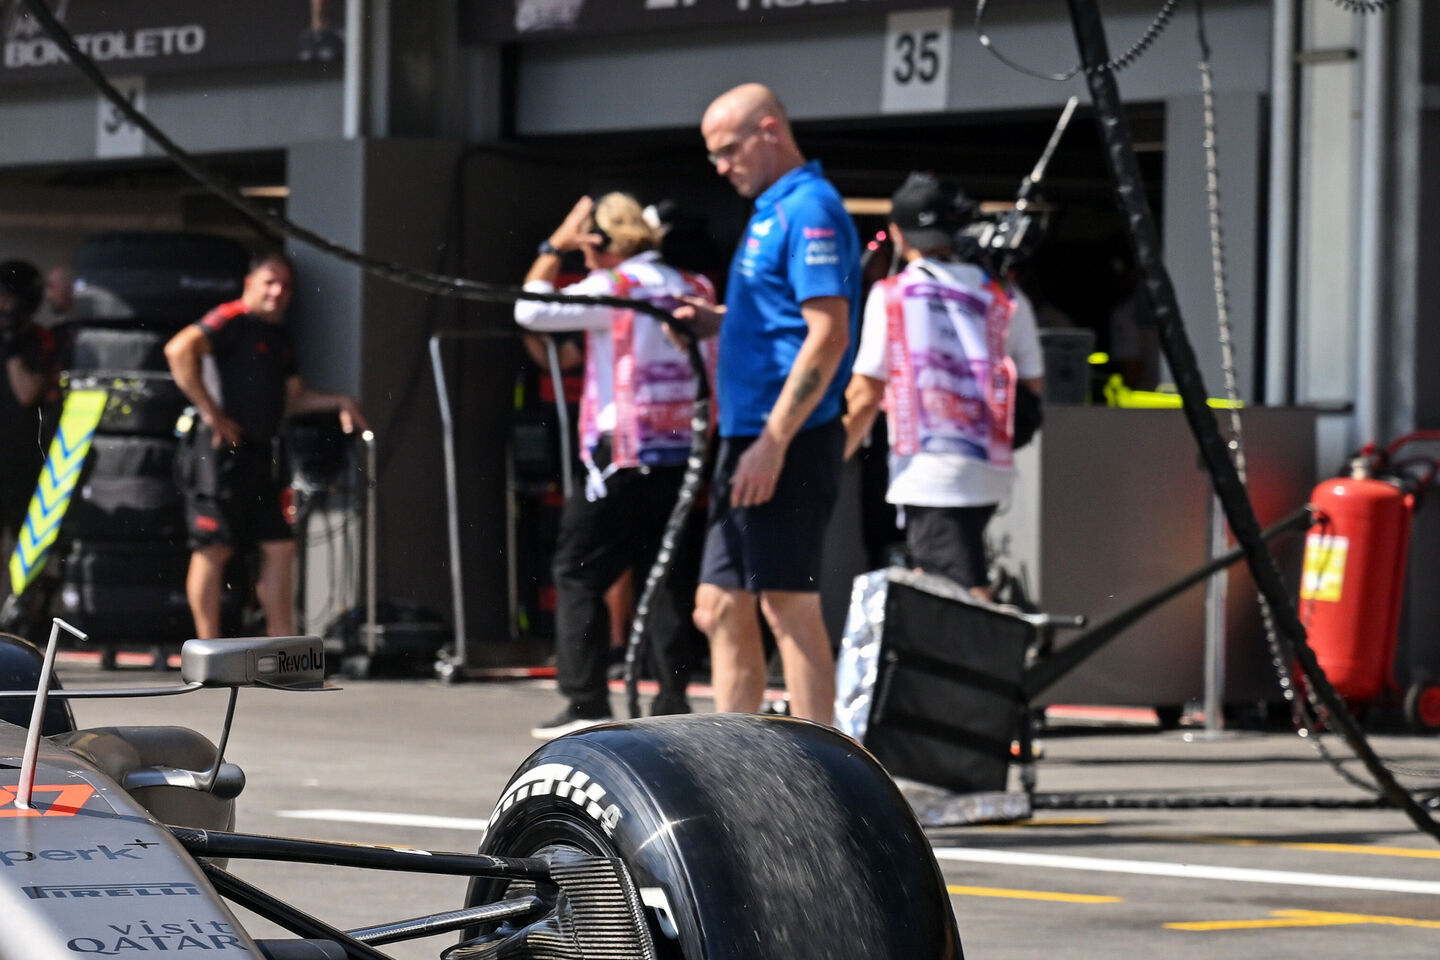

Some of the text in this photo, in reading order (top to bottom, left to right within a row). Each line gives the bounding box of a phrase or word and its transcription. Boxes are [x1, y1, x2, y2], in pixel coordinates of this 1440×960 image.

[893, 31, 940, 85] 35
[21, 881, 201, 900] PIRELLI
[107, 918, 234, 936] visit
[66, 934, 250, 955] QATAR
